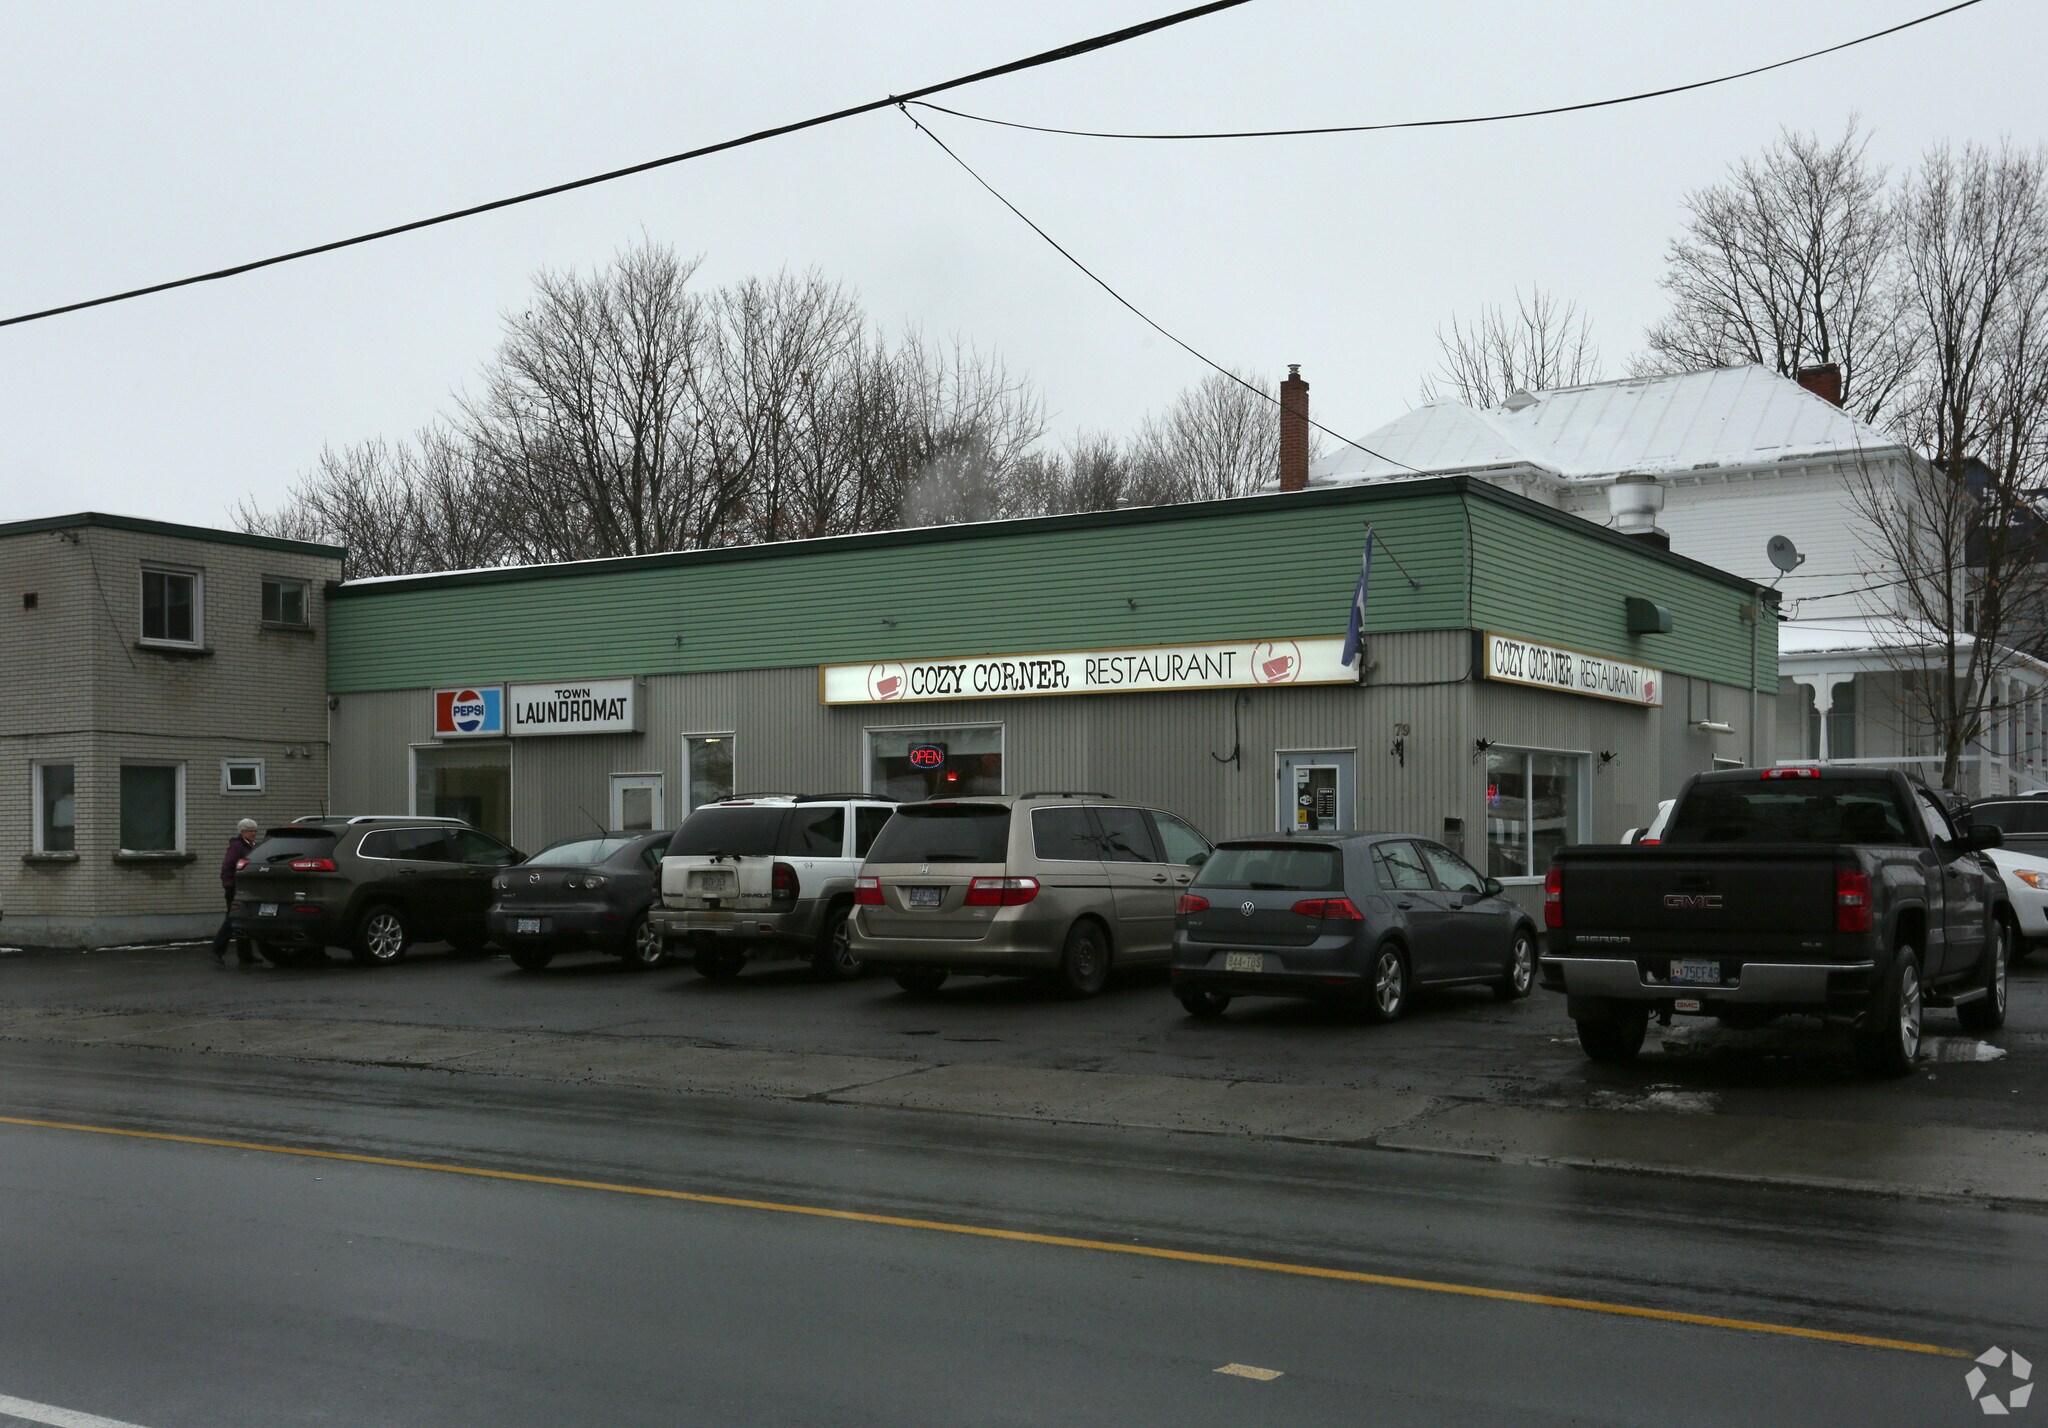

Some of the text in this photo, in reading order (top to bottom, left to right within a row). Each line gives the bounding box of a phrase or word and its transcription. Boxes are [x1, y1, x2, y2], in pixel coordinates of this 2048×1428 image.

[911, 651, 1236, 695] COZY CORNER RESTAURANT
[1494, 639, 1638, 696] COZY CORNER RESTAURANT
[555, 688, 590, 699] TOWN
[453, 705, 484, 717] PEPSI
[516, 698, 627, 724] LAUNDROMAT
[1394, 723, 1410, 736] 79
[911, 750, 942, 764] OPEN
[1663, 894, 1723, 909] GMC
[1576, 935, 1631, 943] SIERRA
